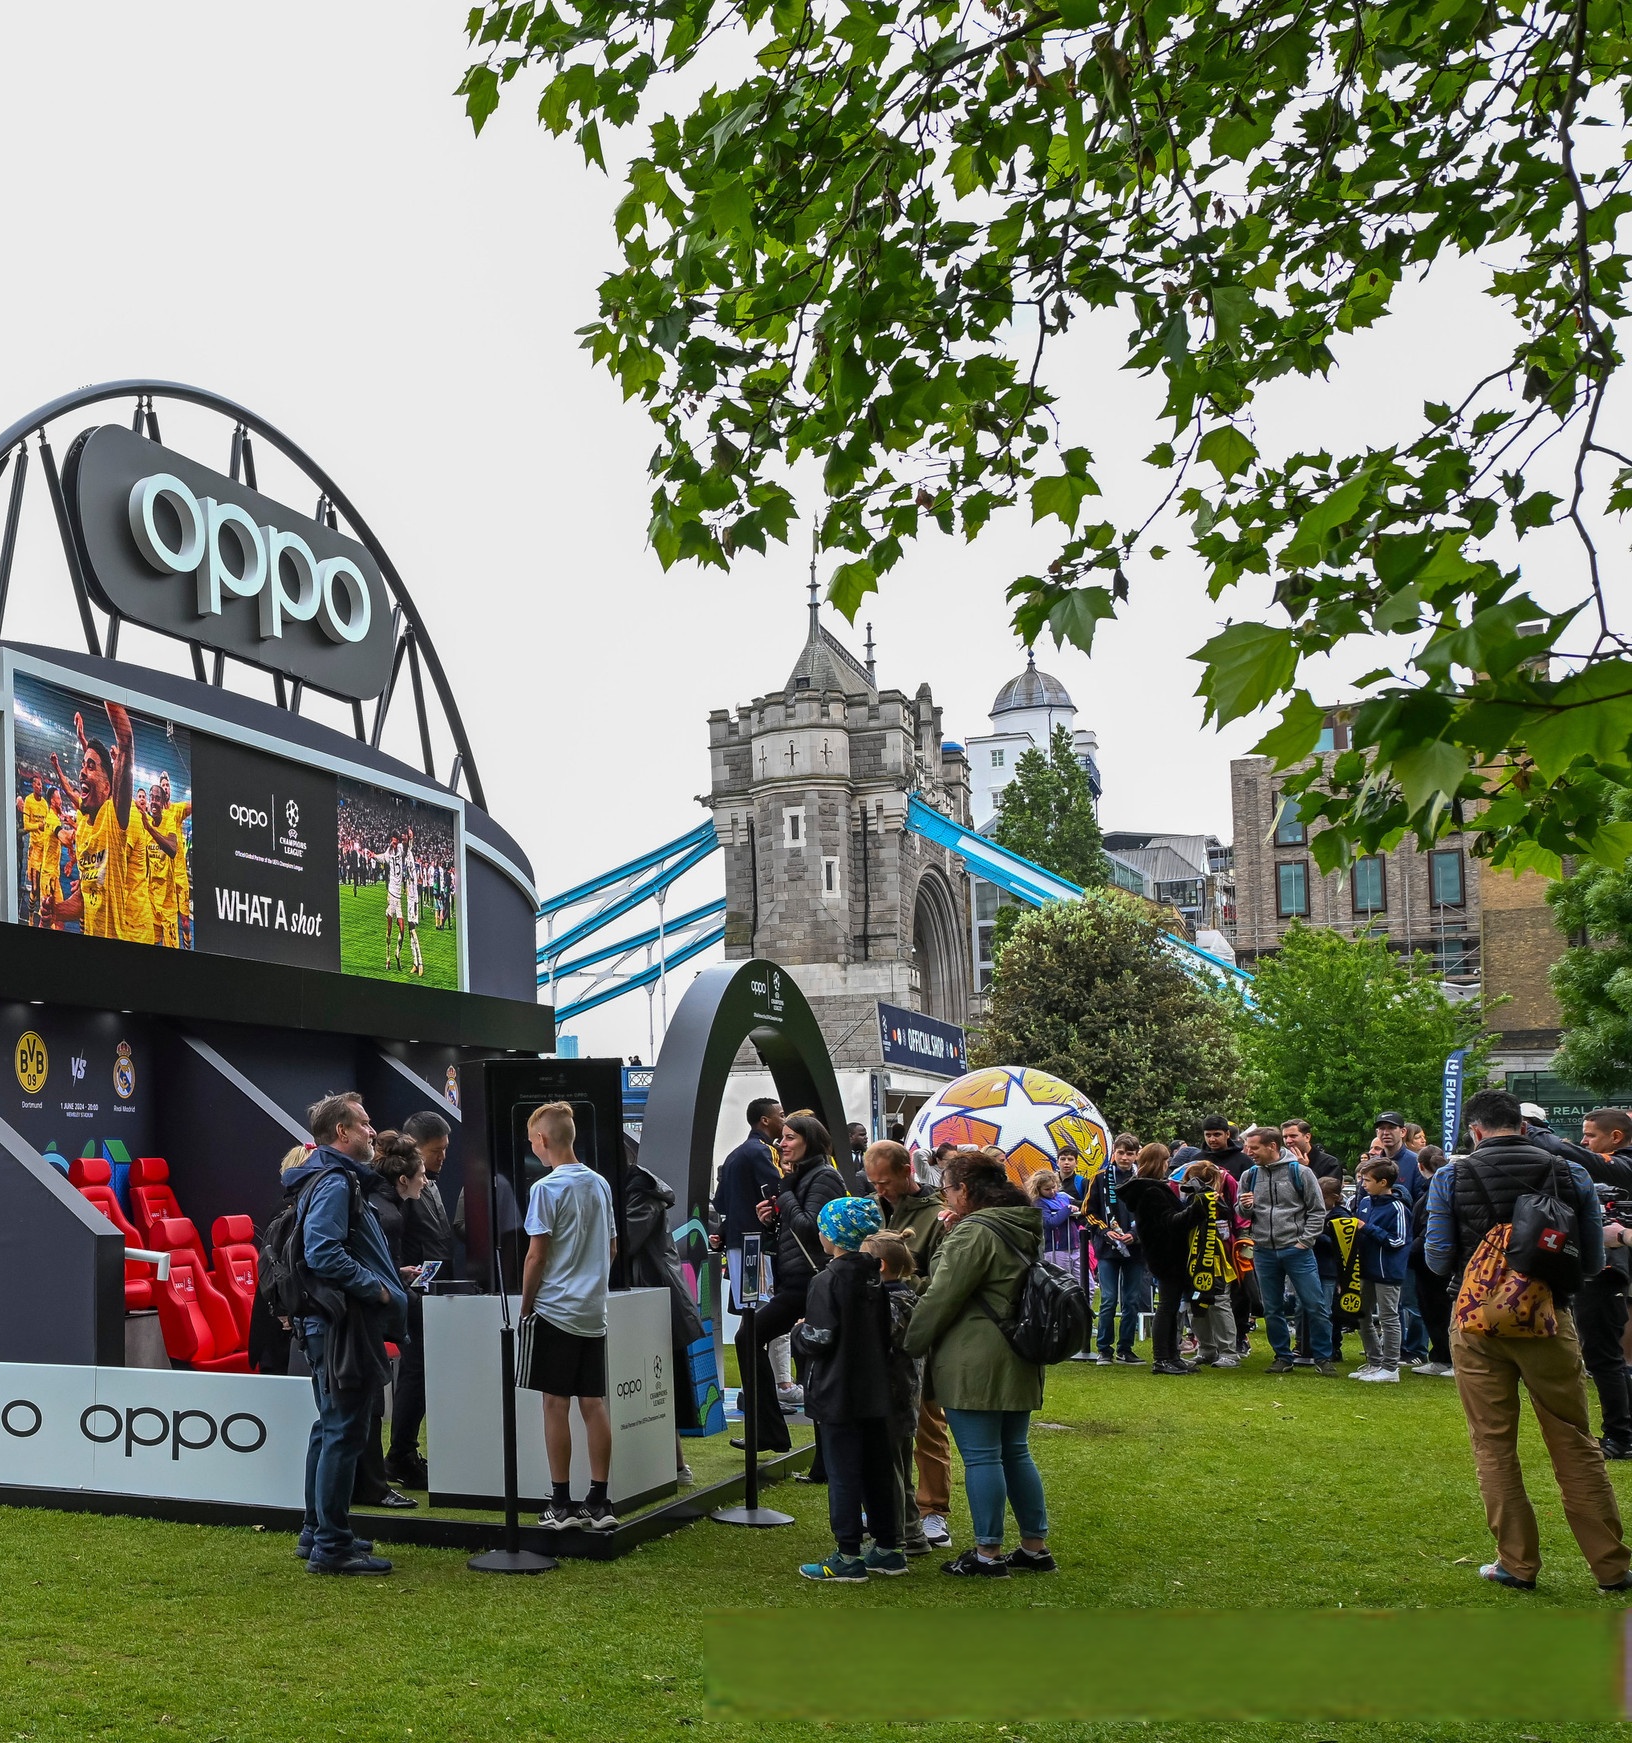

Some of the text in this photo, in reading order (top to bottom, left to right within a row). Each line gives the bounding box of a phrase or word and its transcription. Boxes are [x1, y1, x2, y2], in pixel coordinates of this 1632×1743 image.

[129, 473, 371, 643] oppo
[229, 804, 268, 828] oppo
[279, 837, 307, 850] CHAMPIONS
[284, 846, 303, 857] LEAGUE
[215, 887, 322, 937] WHAT A shot
[908, 1028, 932, 1056] OFFICIAL
[931, 1034, 944, 1059] SHOP
[20, 1038, 44, 1075] BVB
[71, 1056, 87, 1080] VS
[27, 1074, 37, 1086] 09
[21, 1101, 43, 1109] Dortmund
[1553, 1106, 1588, 1115] REAL
[745, 1254, 757, 1267] OUT
[1342, 1295, 1360, 1308] BVB
[617, 1378, 642, 1400] oppo
[80, 1404, 267, 1460] oppo
